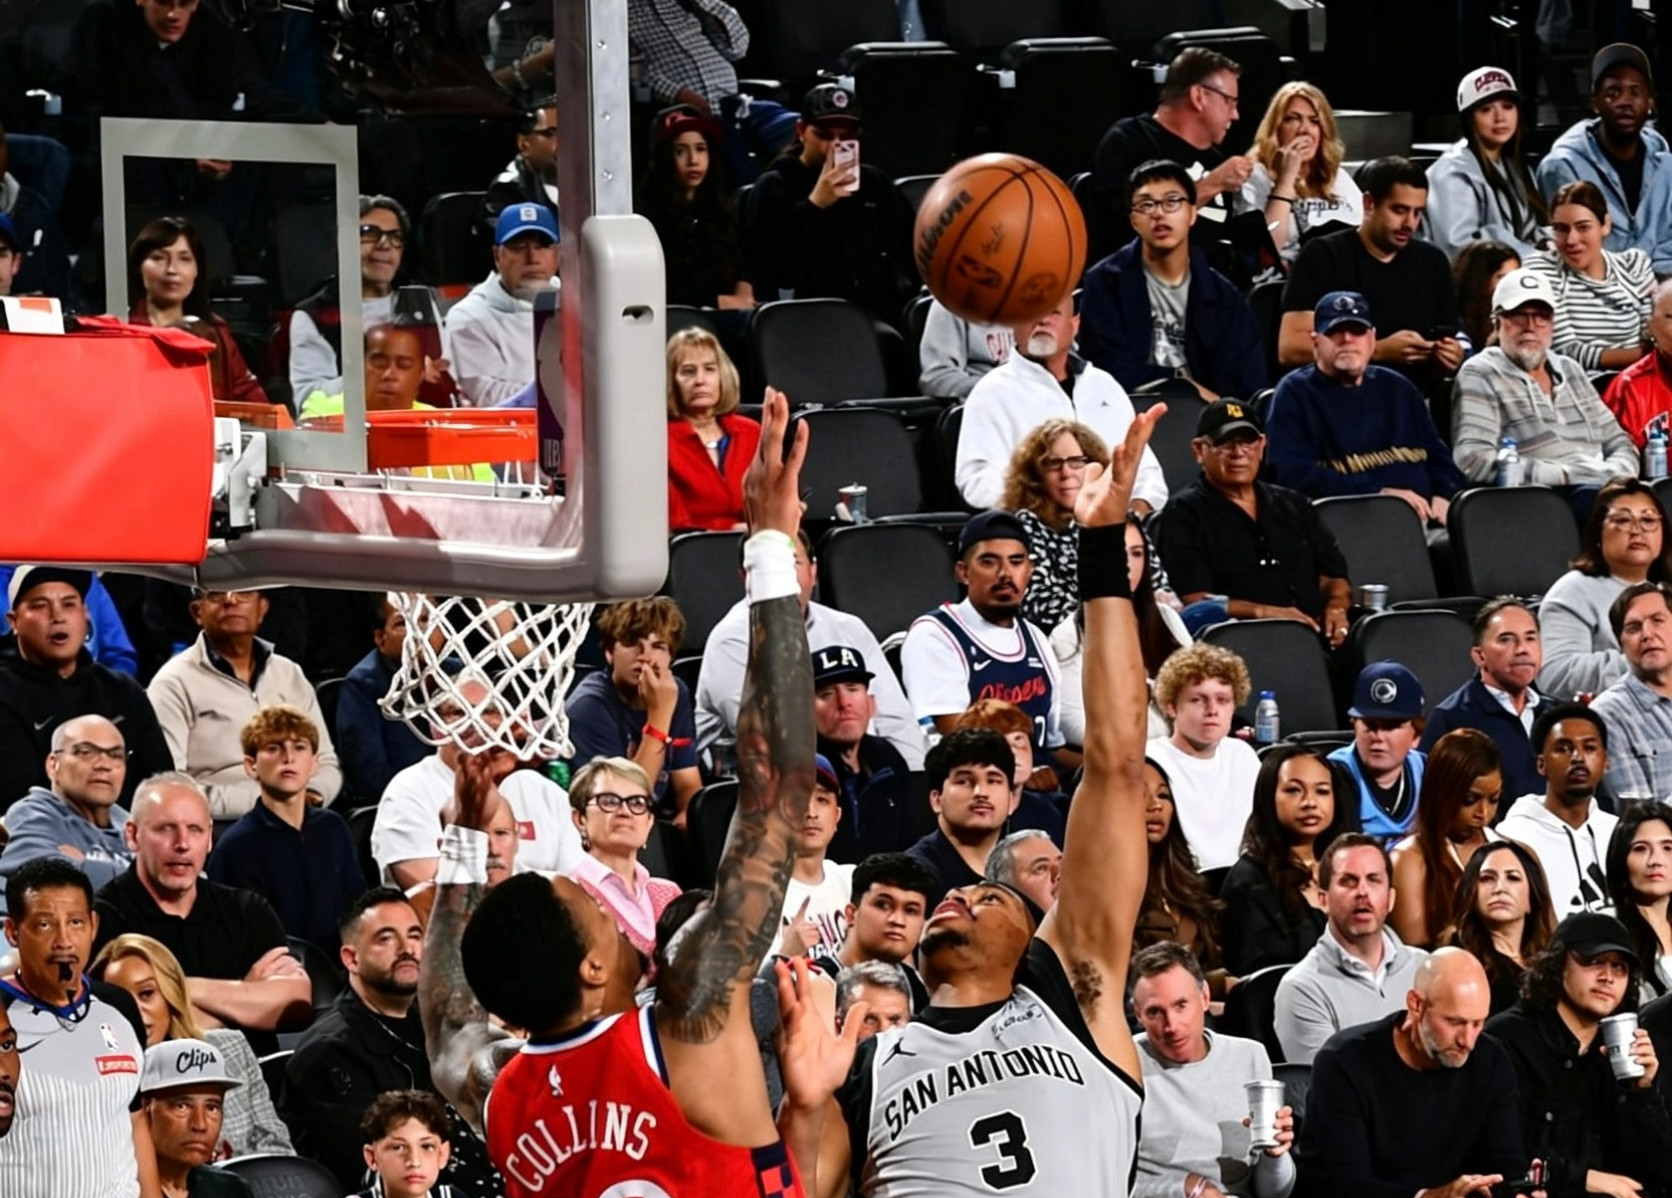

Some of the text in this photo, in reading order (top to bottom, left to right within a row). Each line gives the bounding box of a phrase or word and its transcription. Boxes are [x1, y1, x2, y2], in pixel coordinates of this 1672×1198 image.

[820, 648, 858, 669] LA
[176, 1047, 217, 1074] Clips
[883, 1045, 1086, 1142] SAN ANTONIO
[505, 1100, 657, 1192] COLLINS
[967, 1109, 1038, 1192] 3
